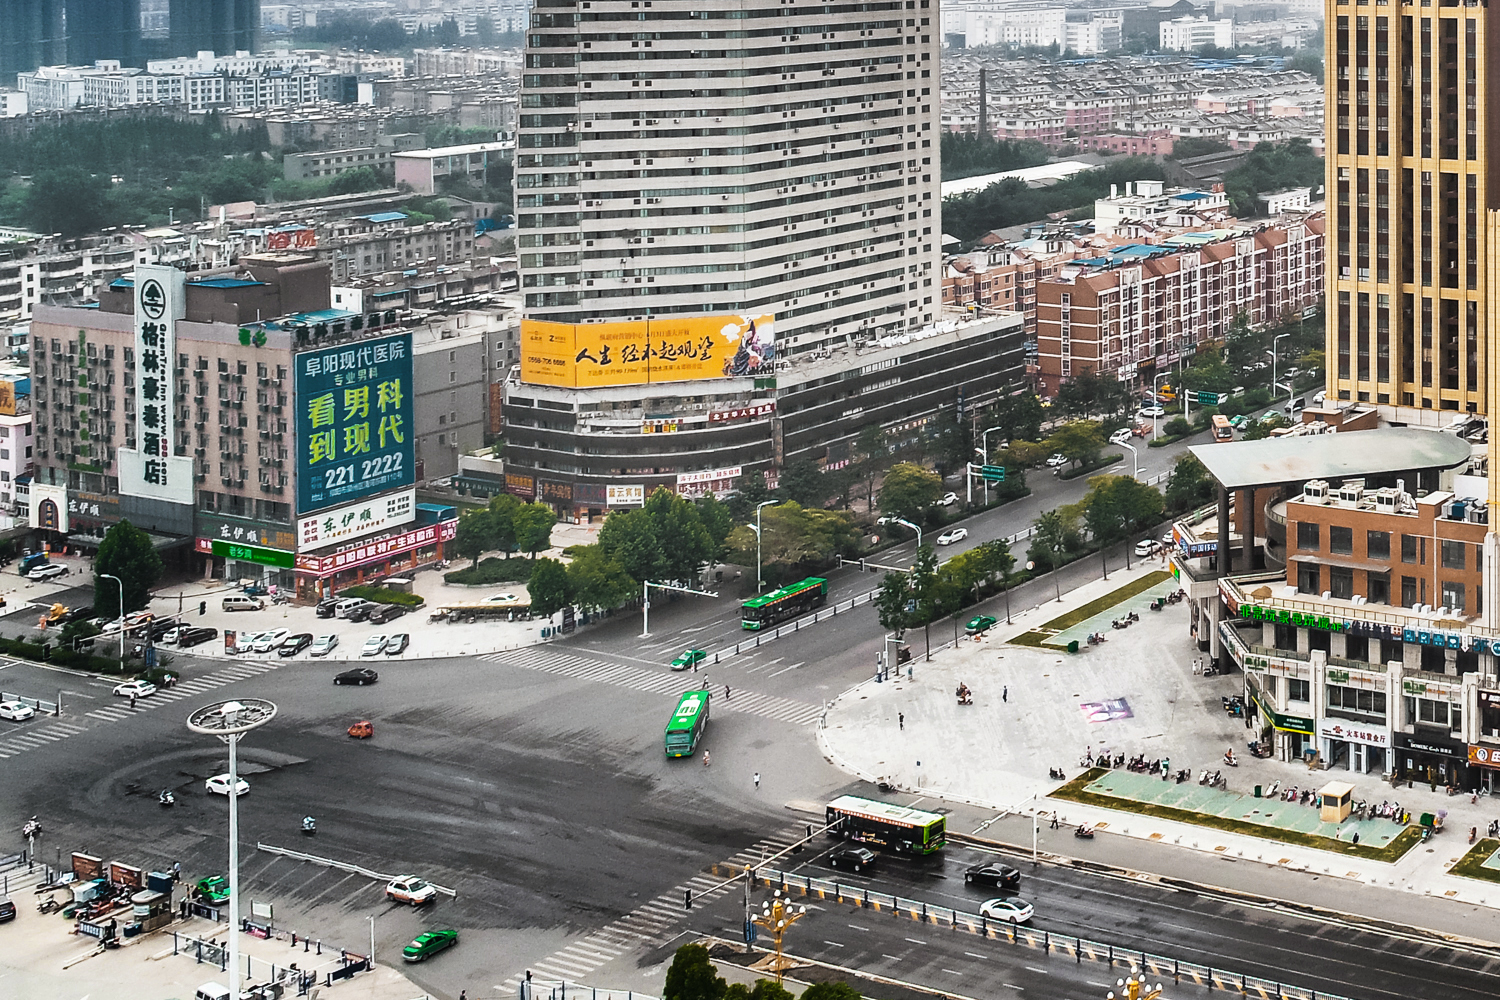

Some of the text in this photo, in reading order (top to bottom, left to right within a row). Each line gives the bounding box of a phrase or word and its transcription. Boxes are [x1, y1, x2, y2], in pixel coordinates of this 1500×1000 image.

[304, 340, 405, 377] 阜阳现代医院
[575, 335, 715, 365] 人生 经不起观望
[334, 366, 379, 386] 专业男科
[141, 321, 160, 485] 格林豪泰酒店
[308, 378, 404, 429] 看男科
[308, 414, 405, 465] 到现代
[325, 464, 354, 489] 221
[361, 452, 403, 480] 2222
[1472, 638, 1490, 652] 3F
[1346, 728, 1386, 743] 火车站营业厅
